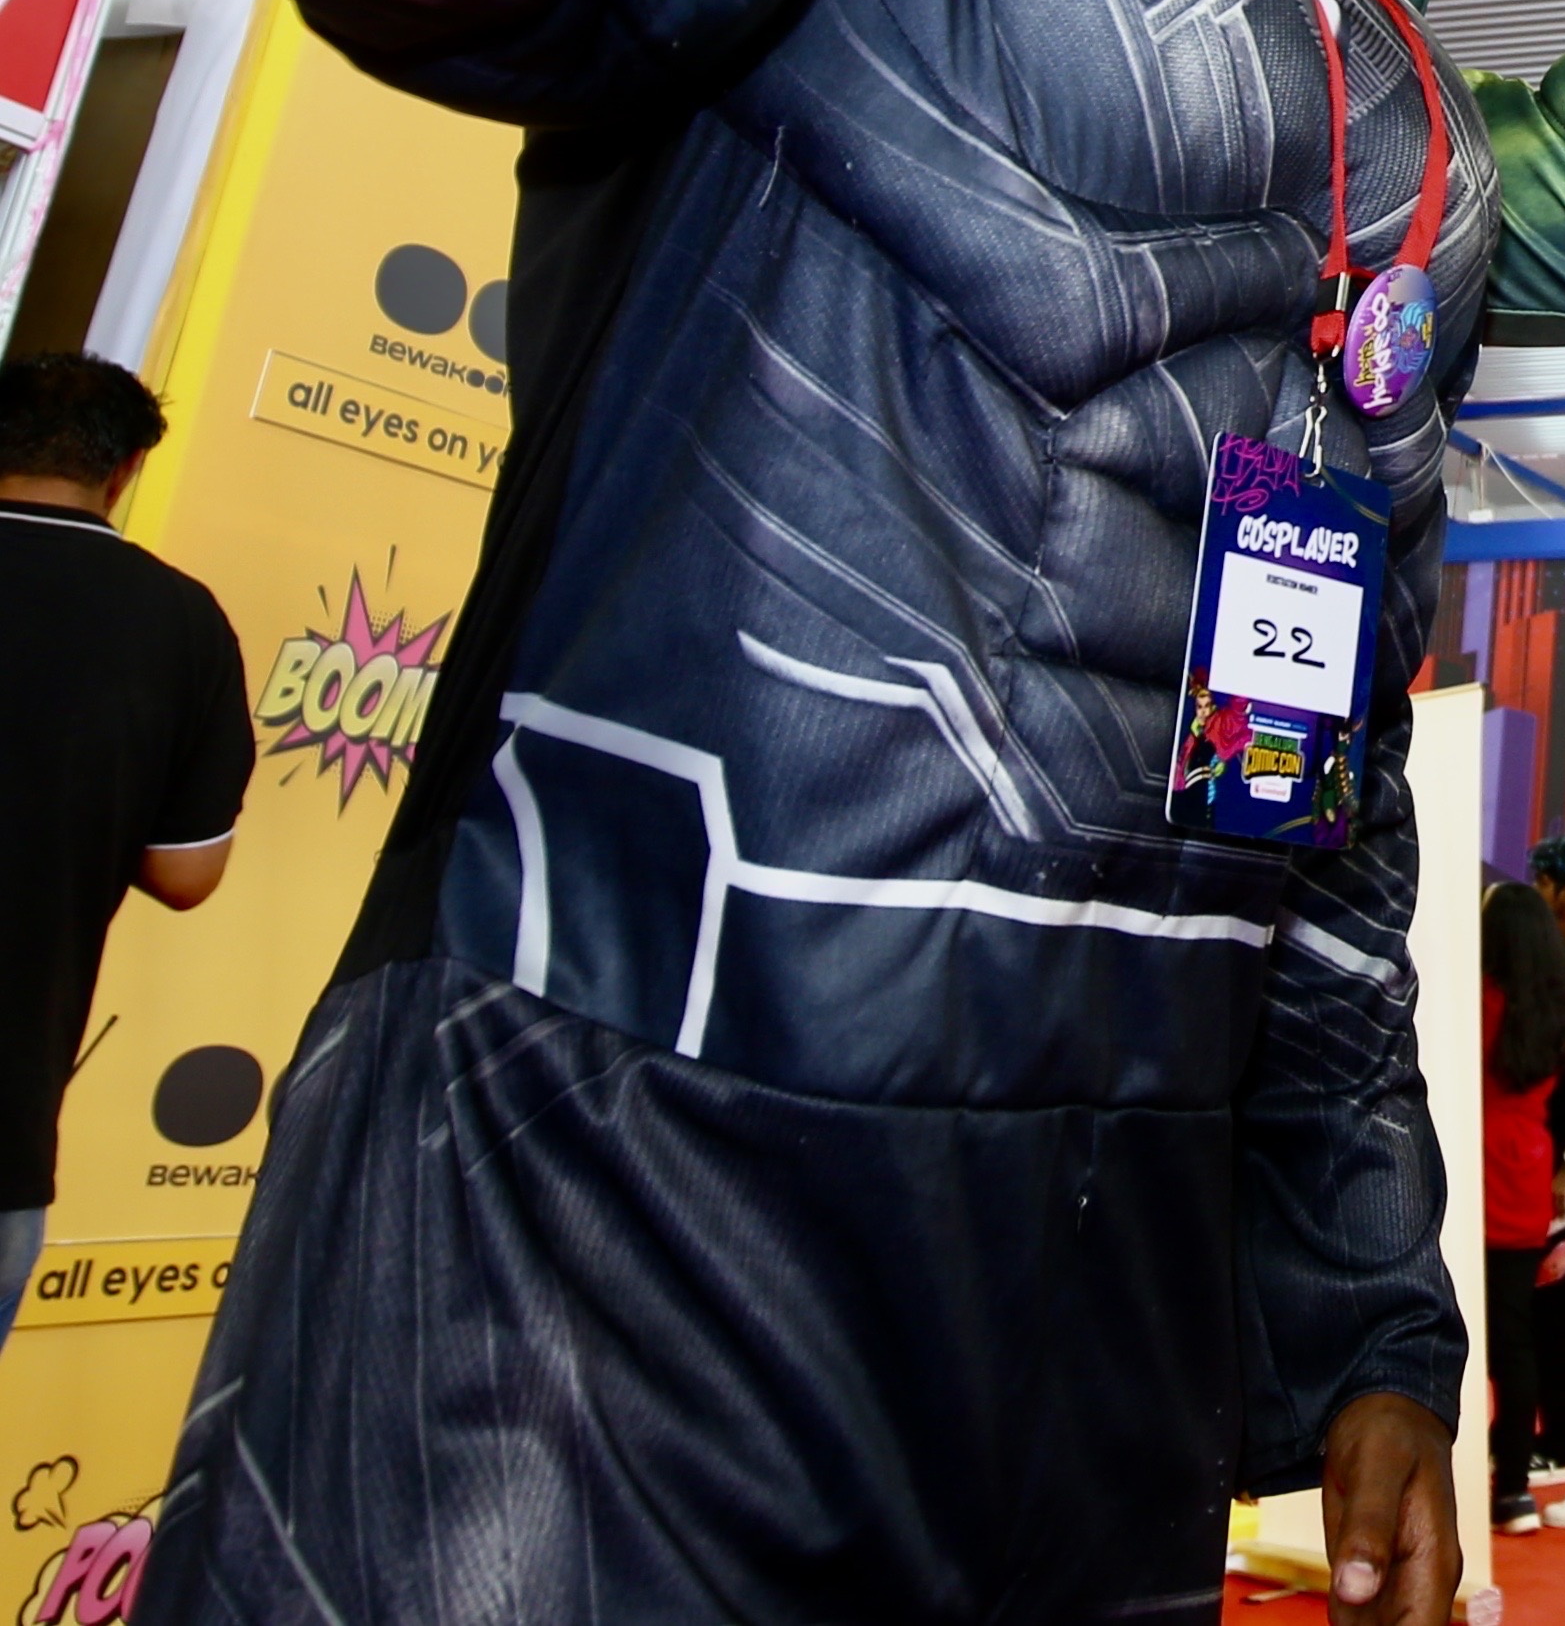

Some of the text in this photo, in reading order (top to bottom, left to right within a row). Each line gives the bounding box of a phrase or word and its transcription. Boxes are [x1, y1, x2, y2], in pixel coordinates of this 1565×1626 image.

[287, 380, 333, 416] all
[339, 399, 420, 444] eyes
[427, 427, 468, 460] on
[1237, 514, 1360, 568] COSPLAYER
[1252, 618, 1326, 669] 22
[254, 637, 441, 748] BOOM
[1244, 746, 1301, 776] COMIC CON
[36, 1258, 94, 1300] all
[102, 1262, 201, 1305] eyes
[33, 1516, 155, 1626] PO
